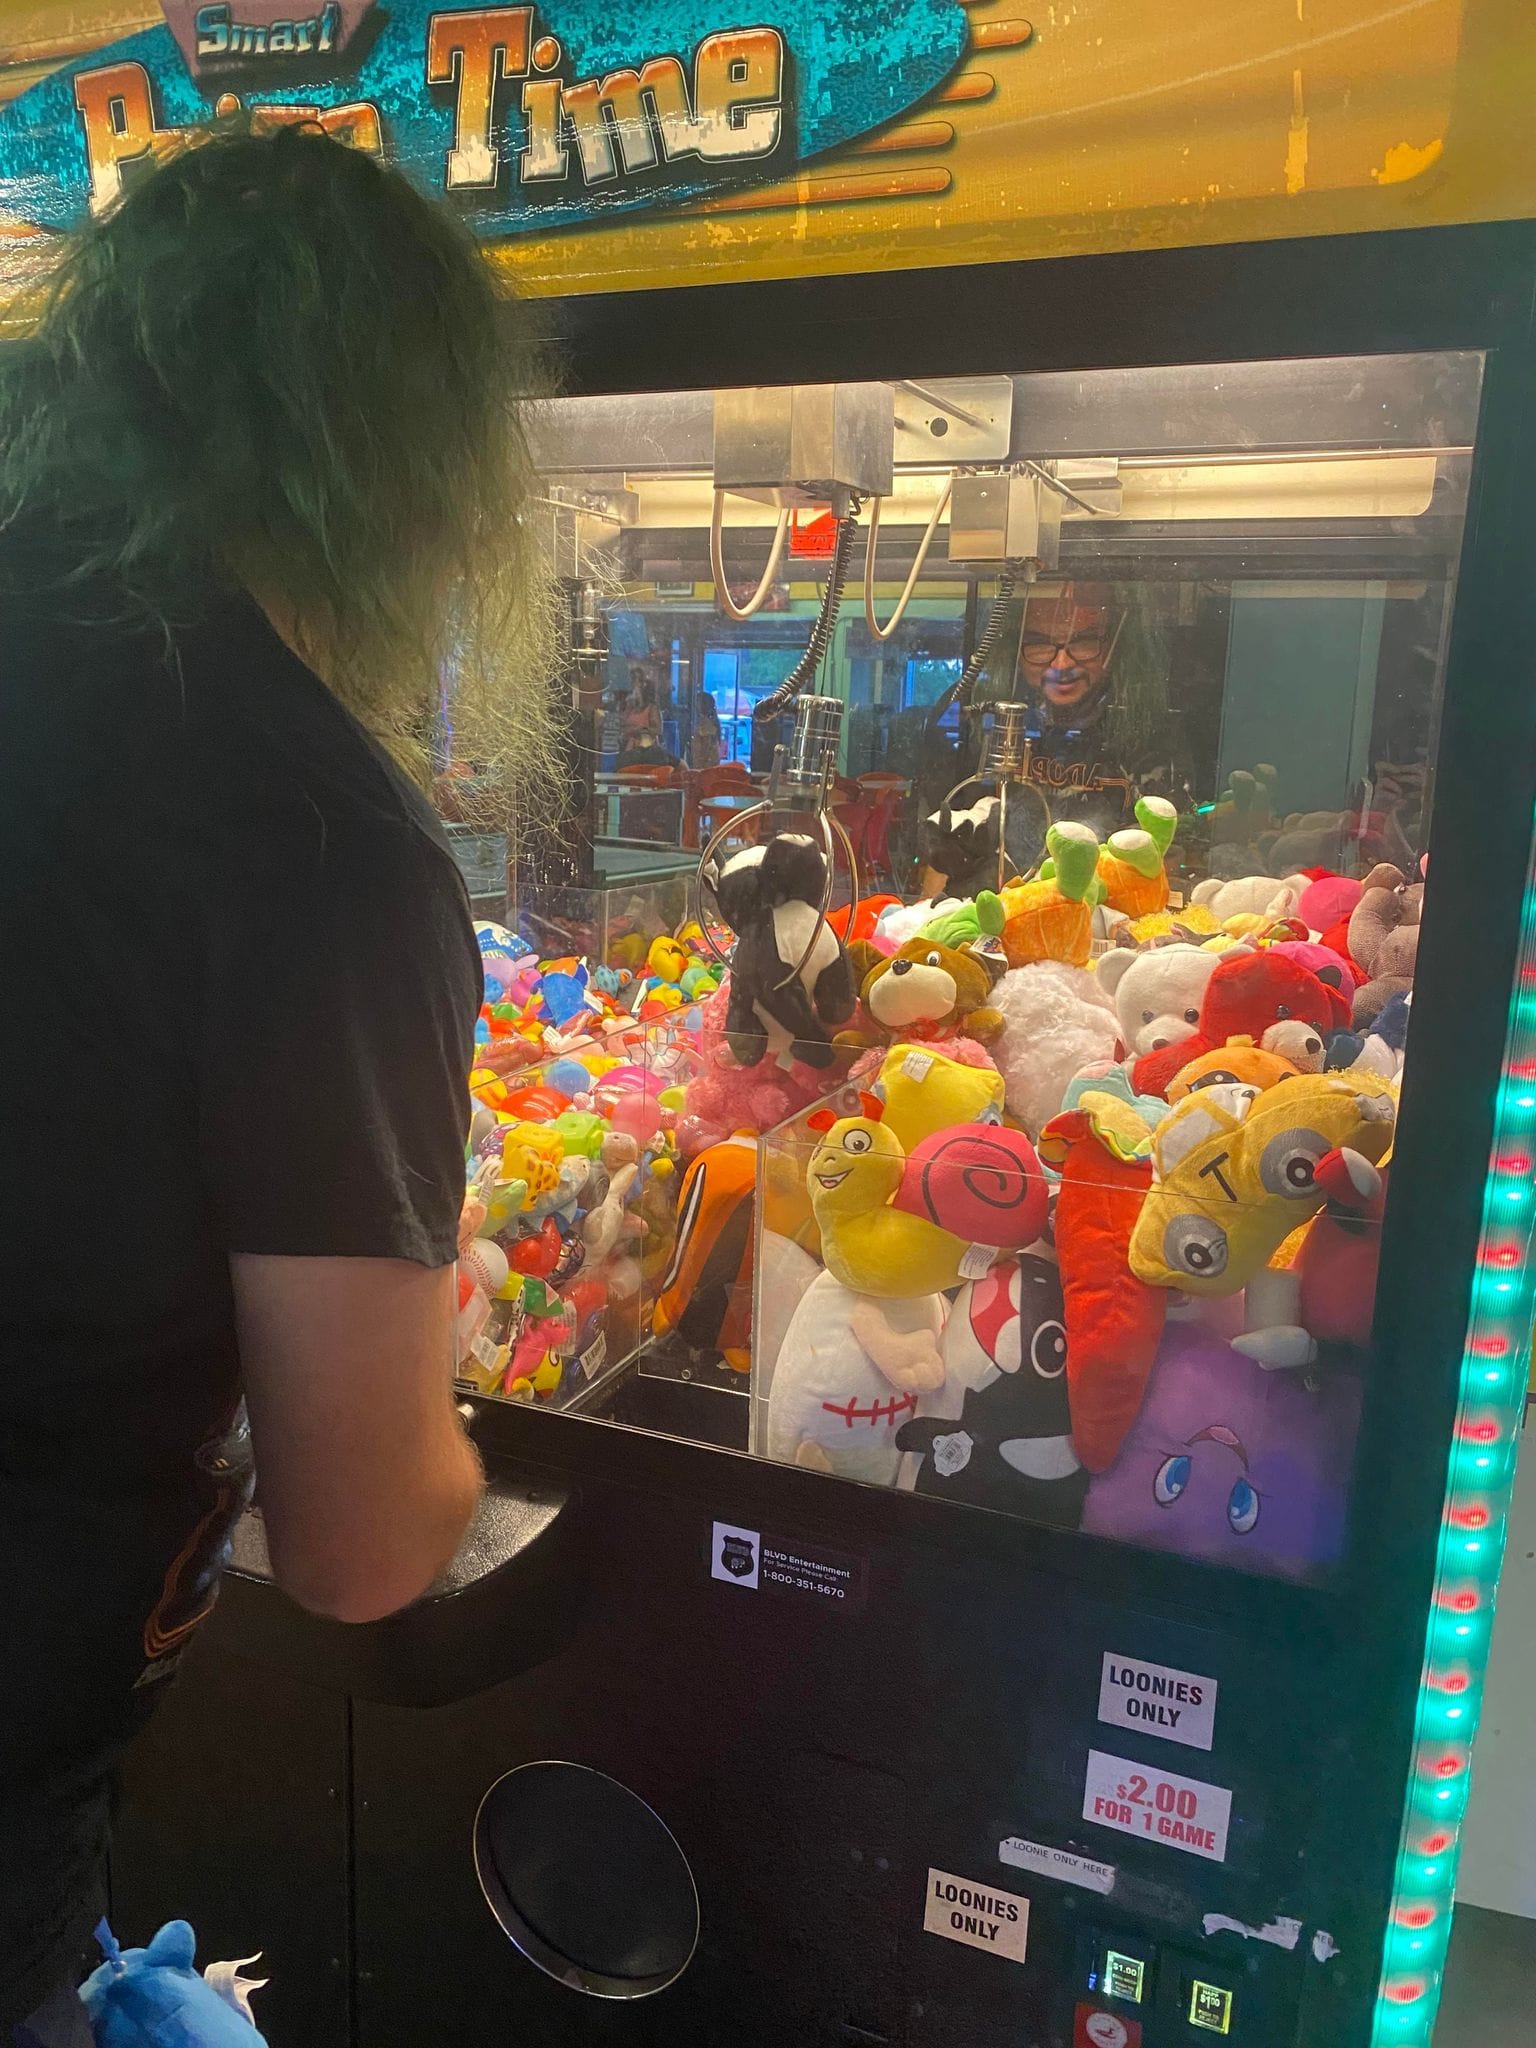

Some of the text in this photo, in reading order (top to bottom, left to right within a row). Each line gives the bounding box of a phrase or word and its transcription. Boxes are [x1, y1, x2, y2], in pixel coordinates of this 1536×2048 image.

[195, 1, 339, 55] Smart
[427, 5, 784, 191] Time
[763, 1549, 788, 1561] BLVD
[789, 1556, 851, 1578] Entertainment
[763, 1558, 775, 1566] For
[776, 1562, 800, 1572] Service
[763, 1569, 845, 1598] 1-800-351-5670
[1109, 1665, 1203, 1706] LOONIES
[1126, 1698, 1182, 1728] ONLY
[1116, 1774, 1198, 1820] $2.00
[1094, 1796, 1217, 1851] FOR 1 GAME
[1013, 1840, 1109, 1877] LOONIE ONLY HERE
[935, 1880, 1019, 1923] LOONIES
[950, 1911, 1001, 1942] ONLY
